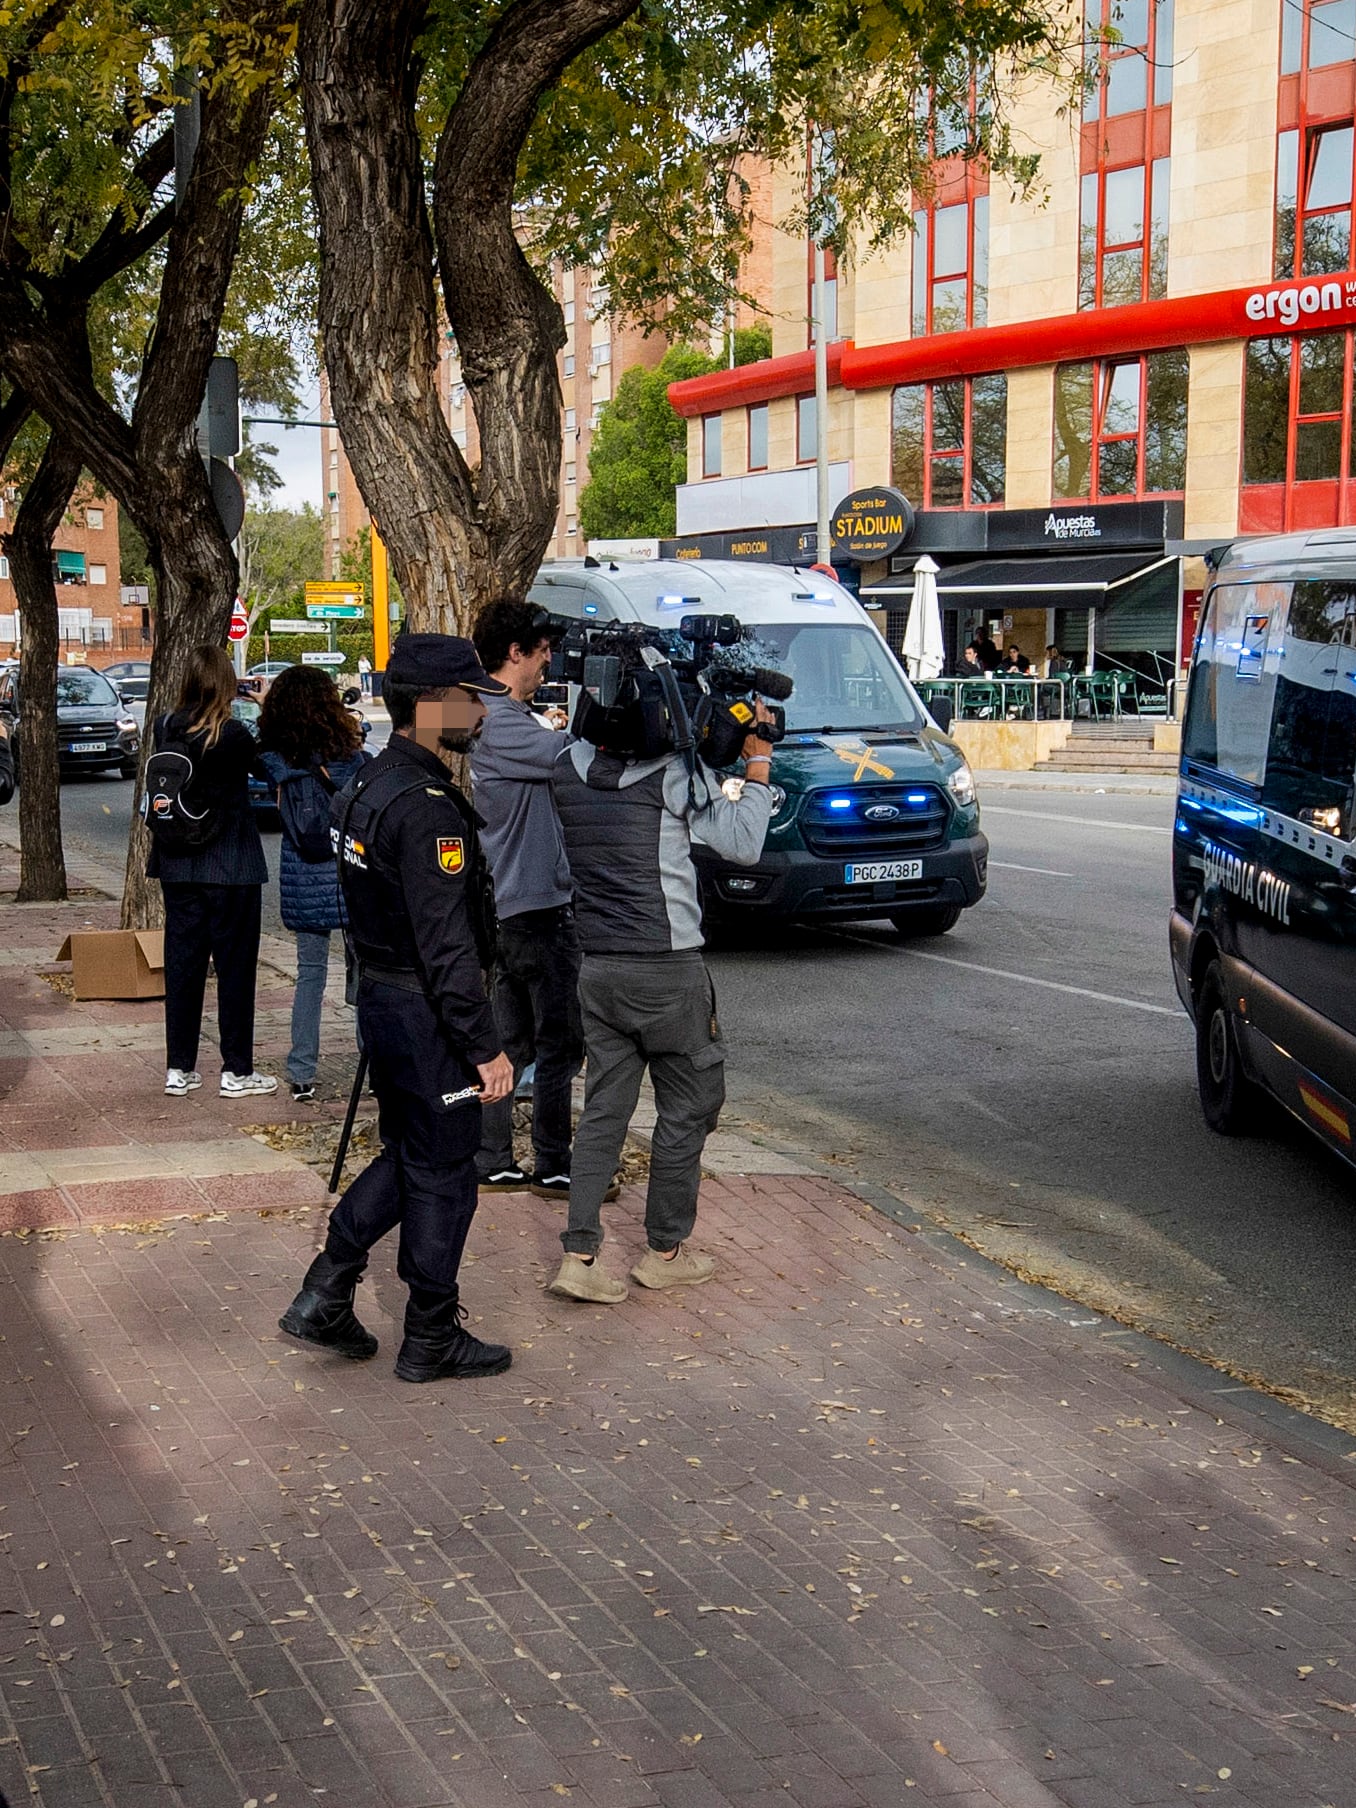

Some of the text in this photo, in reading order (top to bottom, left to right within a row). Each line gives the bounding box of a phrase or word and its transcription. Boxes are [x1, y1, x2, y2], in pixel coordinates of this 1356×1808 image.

[1245, 282, 1342, 325] ergon
[836, 515, 903, 537] STADIUM
[1044, 513, 1096, 538] Apuestas
[230, 624, 247, 632] TOP
[853, 862, 919, 881] PGC 2438 P
[1203, 842, 1290, 926] GUARDIA CIVIL
